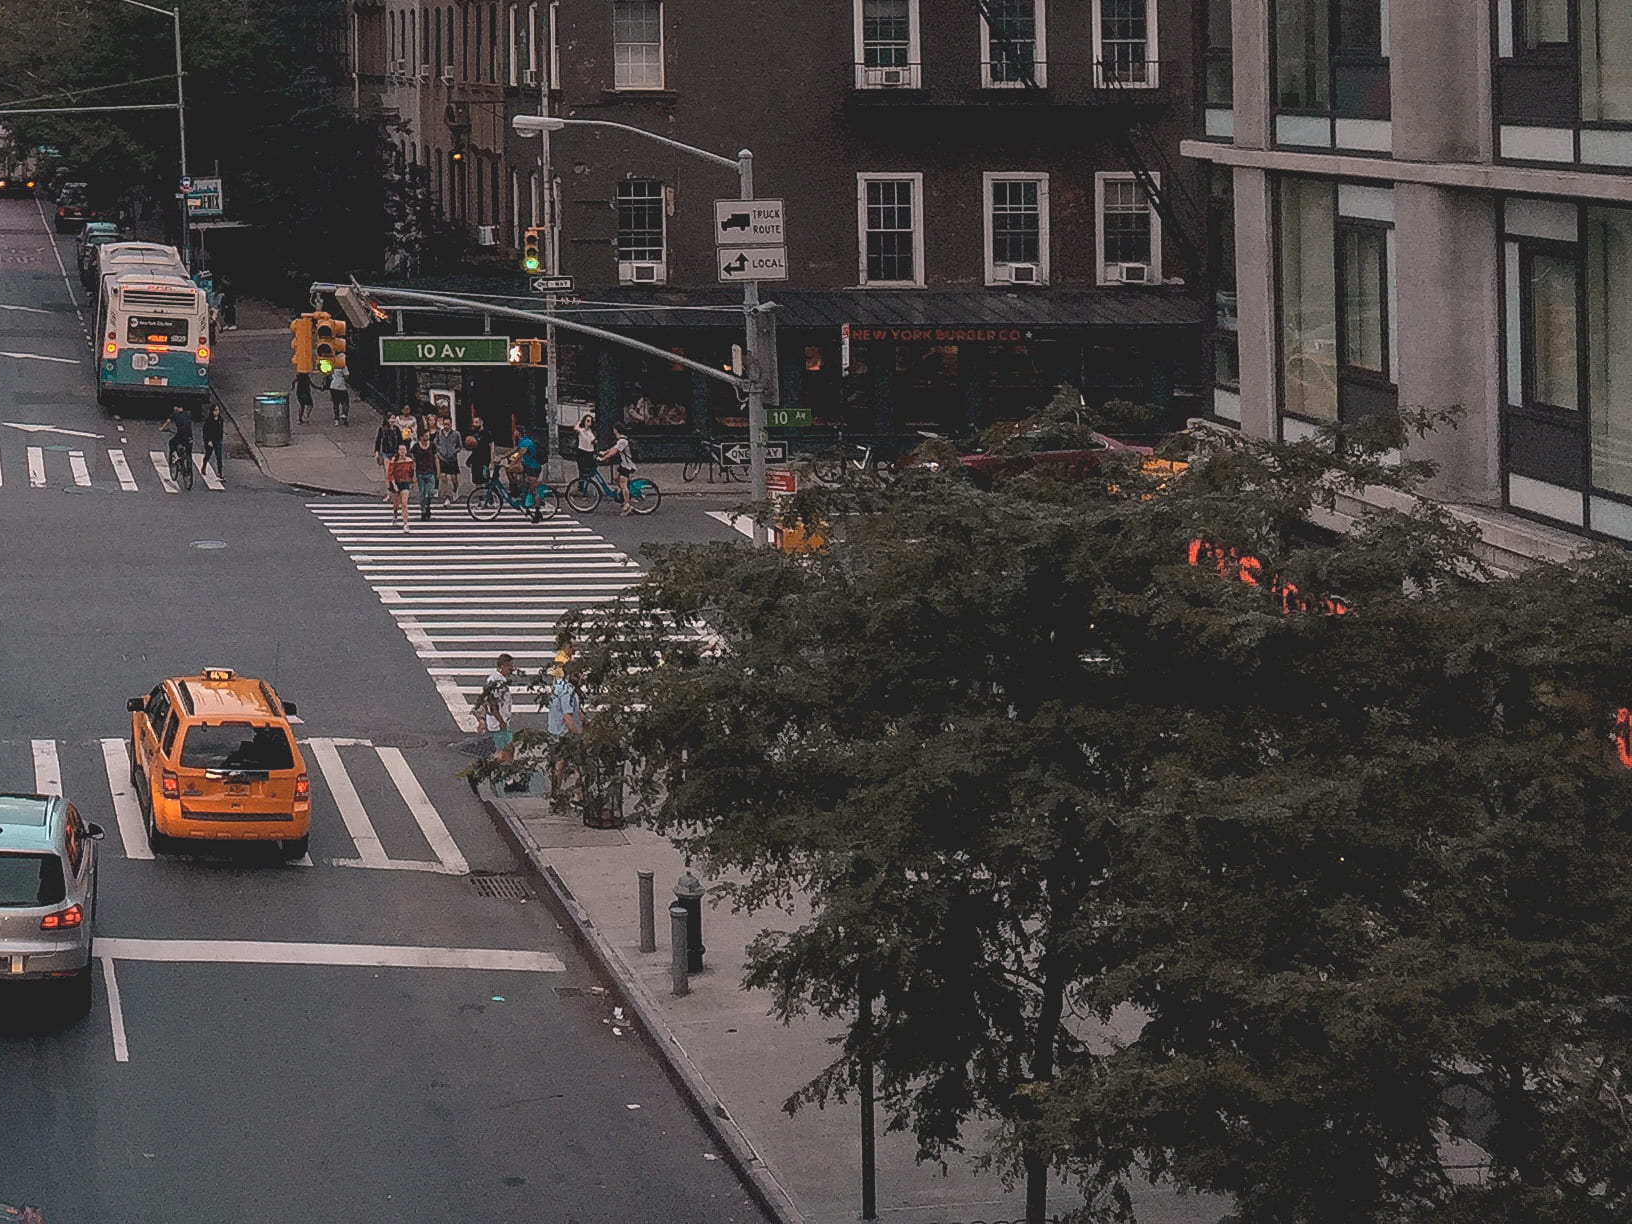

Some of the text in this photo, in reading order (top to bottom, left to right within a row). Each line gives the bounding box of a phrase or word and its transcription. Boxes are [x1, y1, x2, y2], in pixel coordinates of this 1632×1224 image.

[752, 209, 780, 220] TRUCK
[753, 225, 781, 234] ROUTE
[752, 259, 784, 268] LOCAL
[853, 329, 1021, 341] NEW YORK BURGER CO
[417, 343, 465, 358] 10 Av
[773, 411, 788, 424] 10
